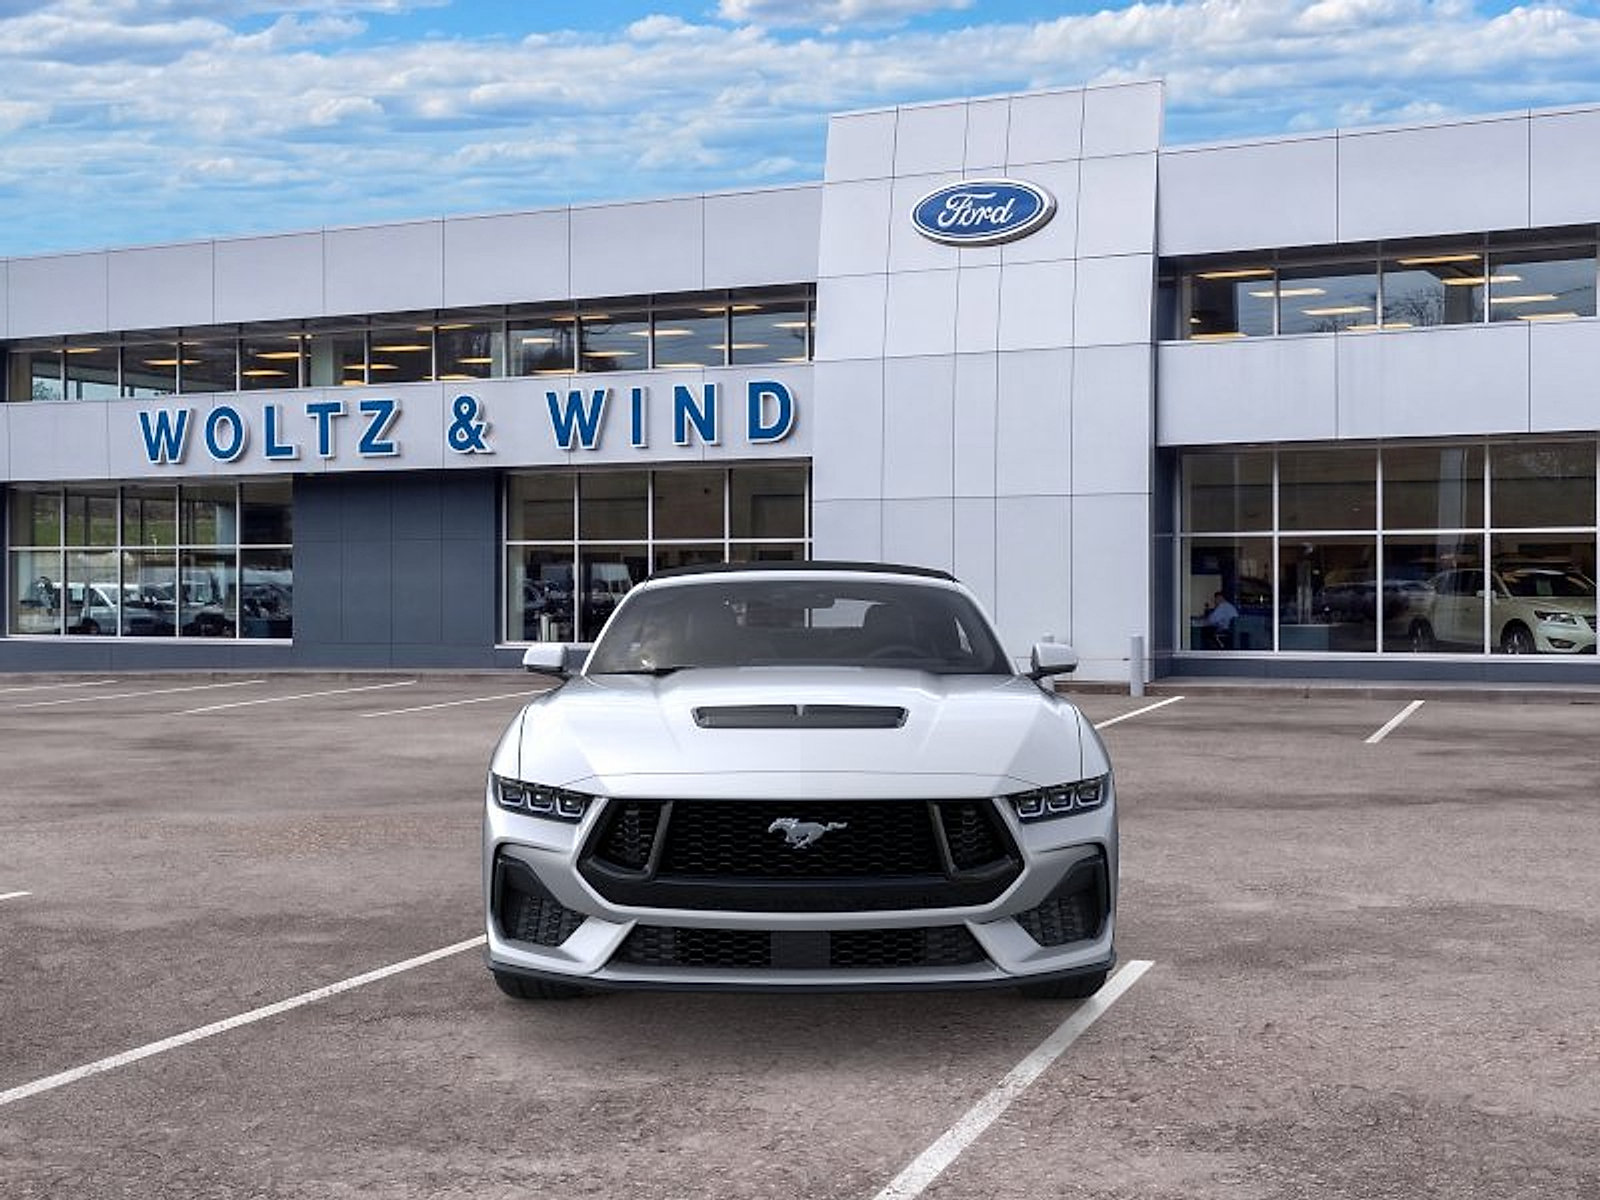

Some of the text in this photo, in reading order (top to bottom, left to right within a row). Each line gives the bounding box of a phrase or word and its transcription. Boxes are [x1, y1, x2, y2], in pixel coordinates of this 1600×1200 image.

[938, 191, 1016, 228] Ford
[138, 380, 796, 464] WOLTZ & WIND
